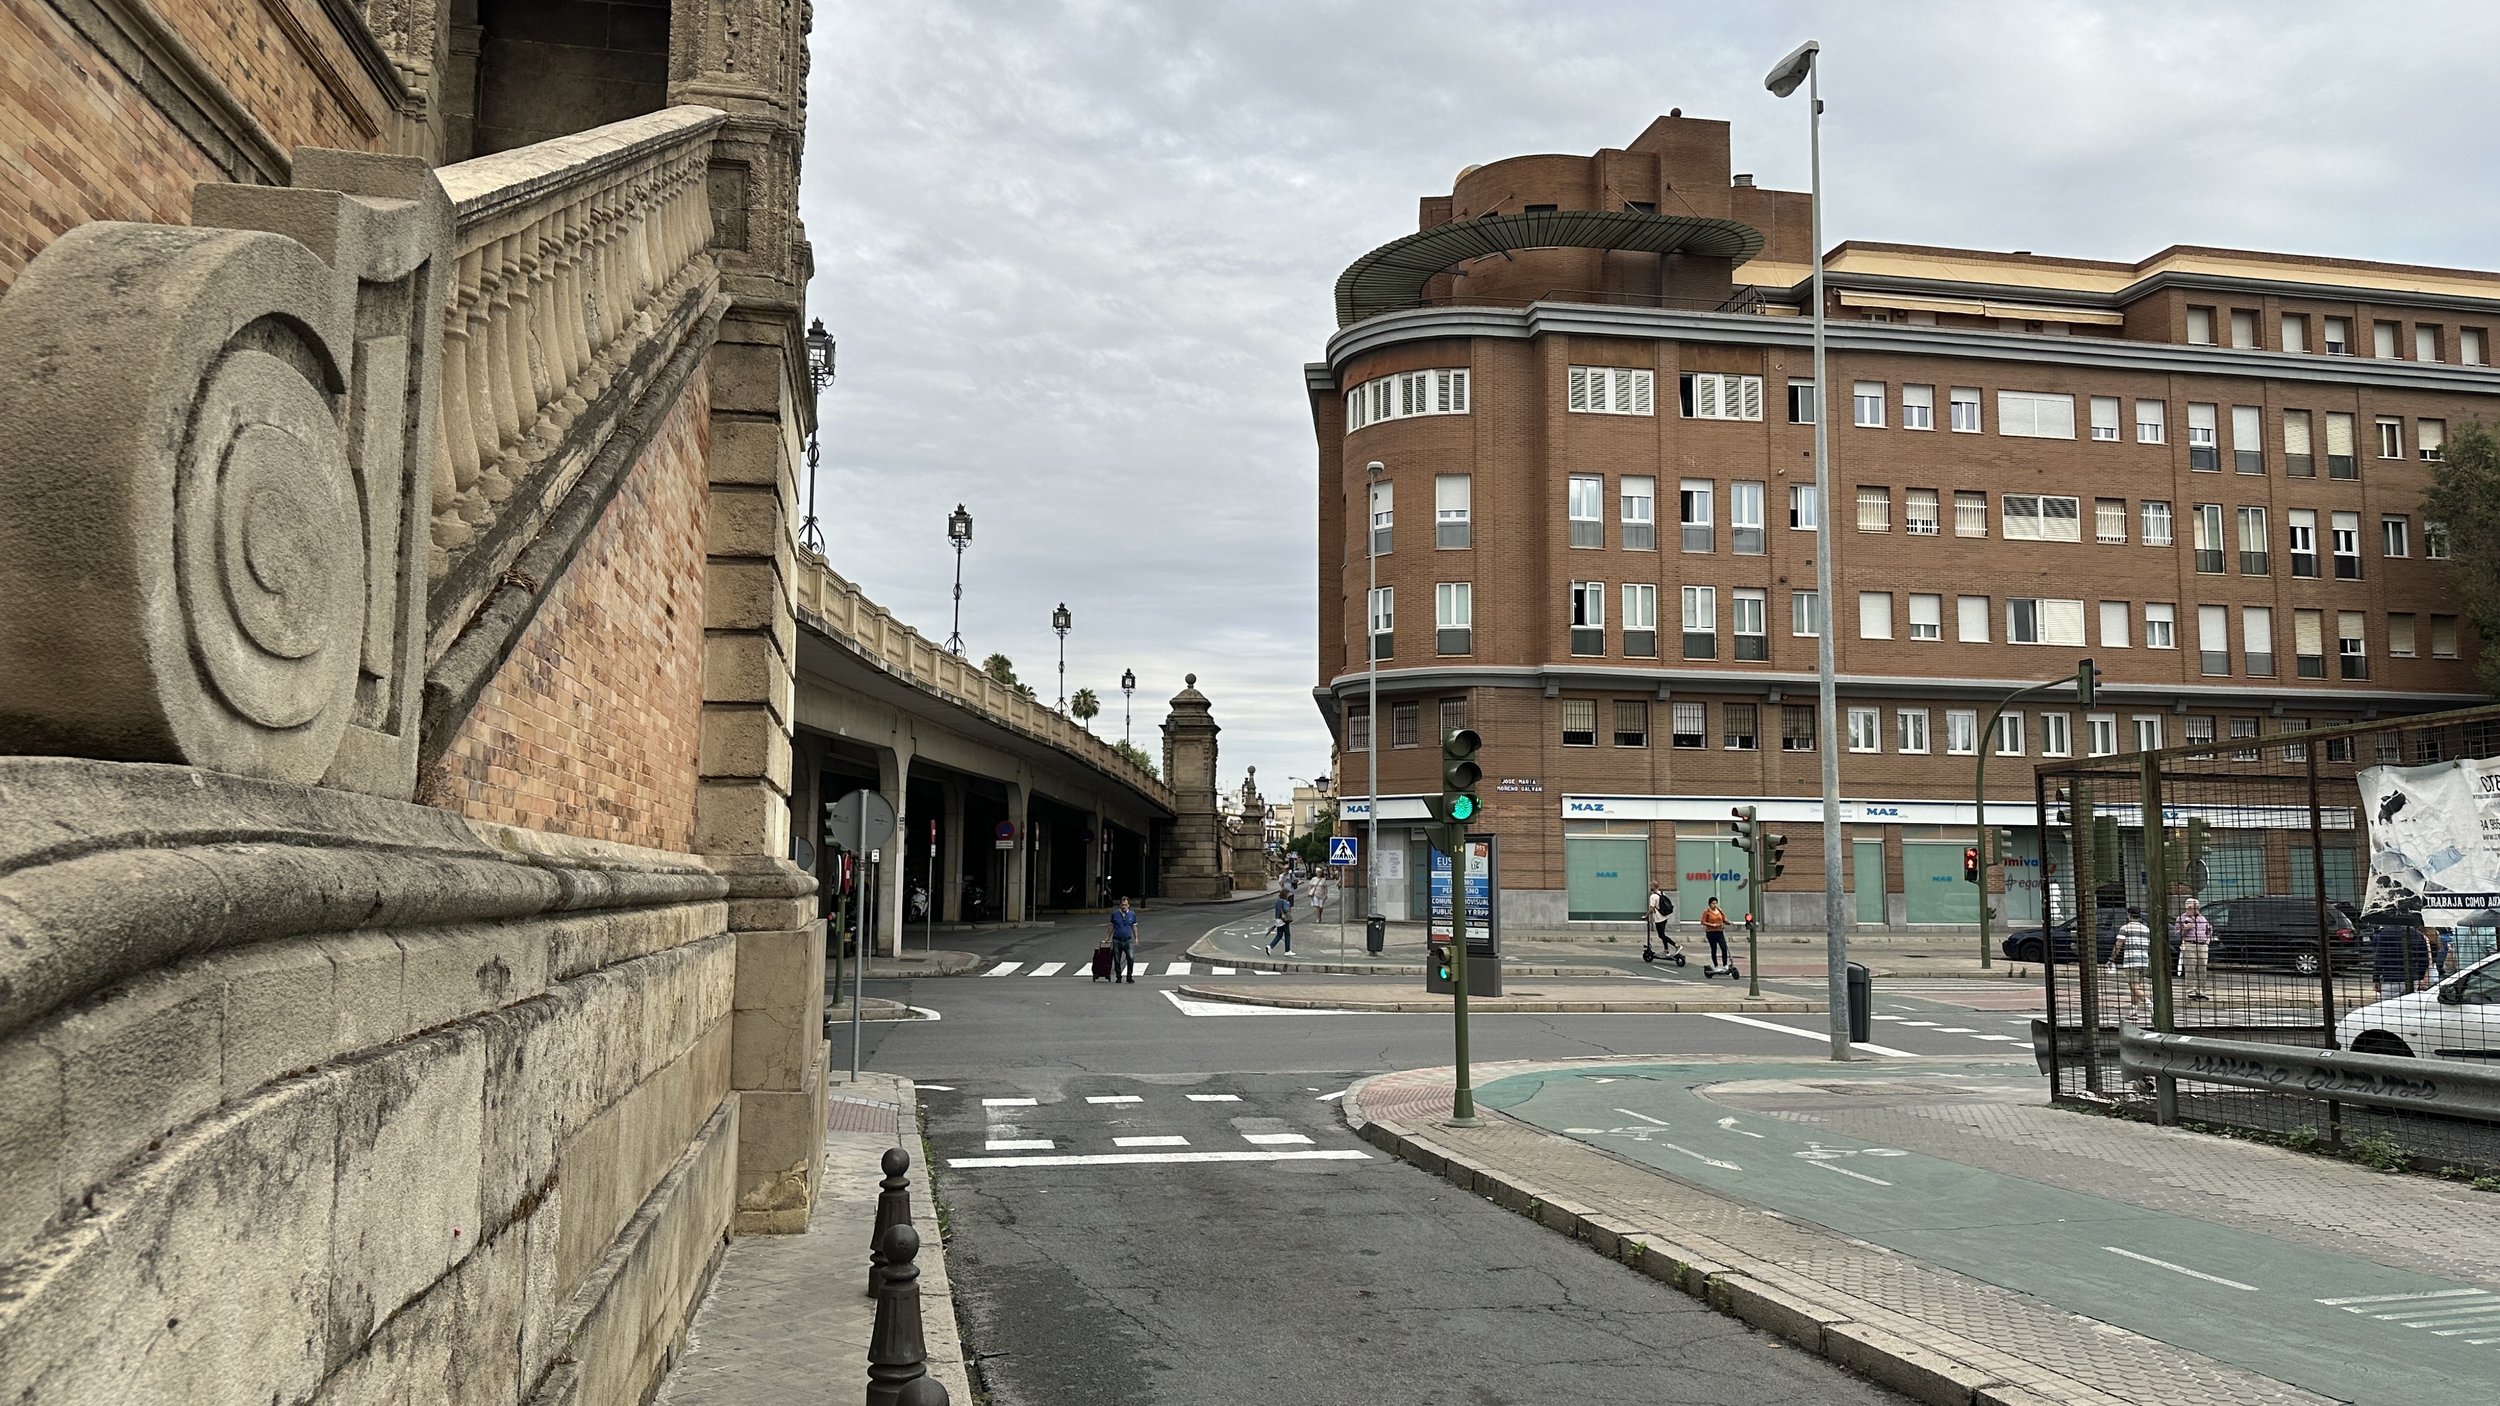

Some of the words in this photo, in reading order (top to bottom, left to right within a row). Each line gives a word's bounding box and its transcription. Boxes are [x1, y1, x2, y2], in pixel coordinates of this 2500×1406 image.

[1571, 803, 1604, 811] MAZ
[1867, 807, 1898, 816] MAZ
[1437, 856, 1452, 866] EUS
[1686, 869, 1741, 881] umivale
[2426, 896, 2463, 907] TRABAJA
[2465, 896, 2485, 907] COMO
